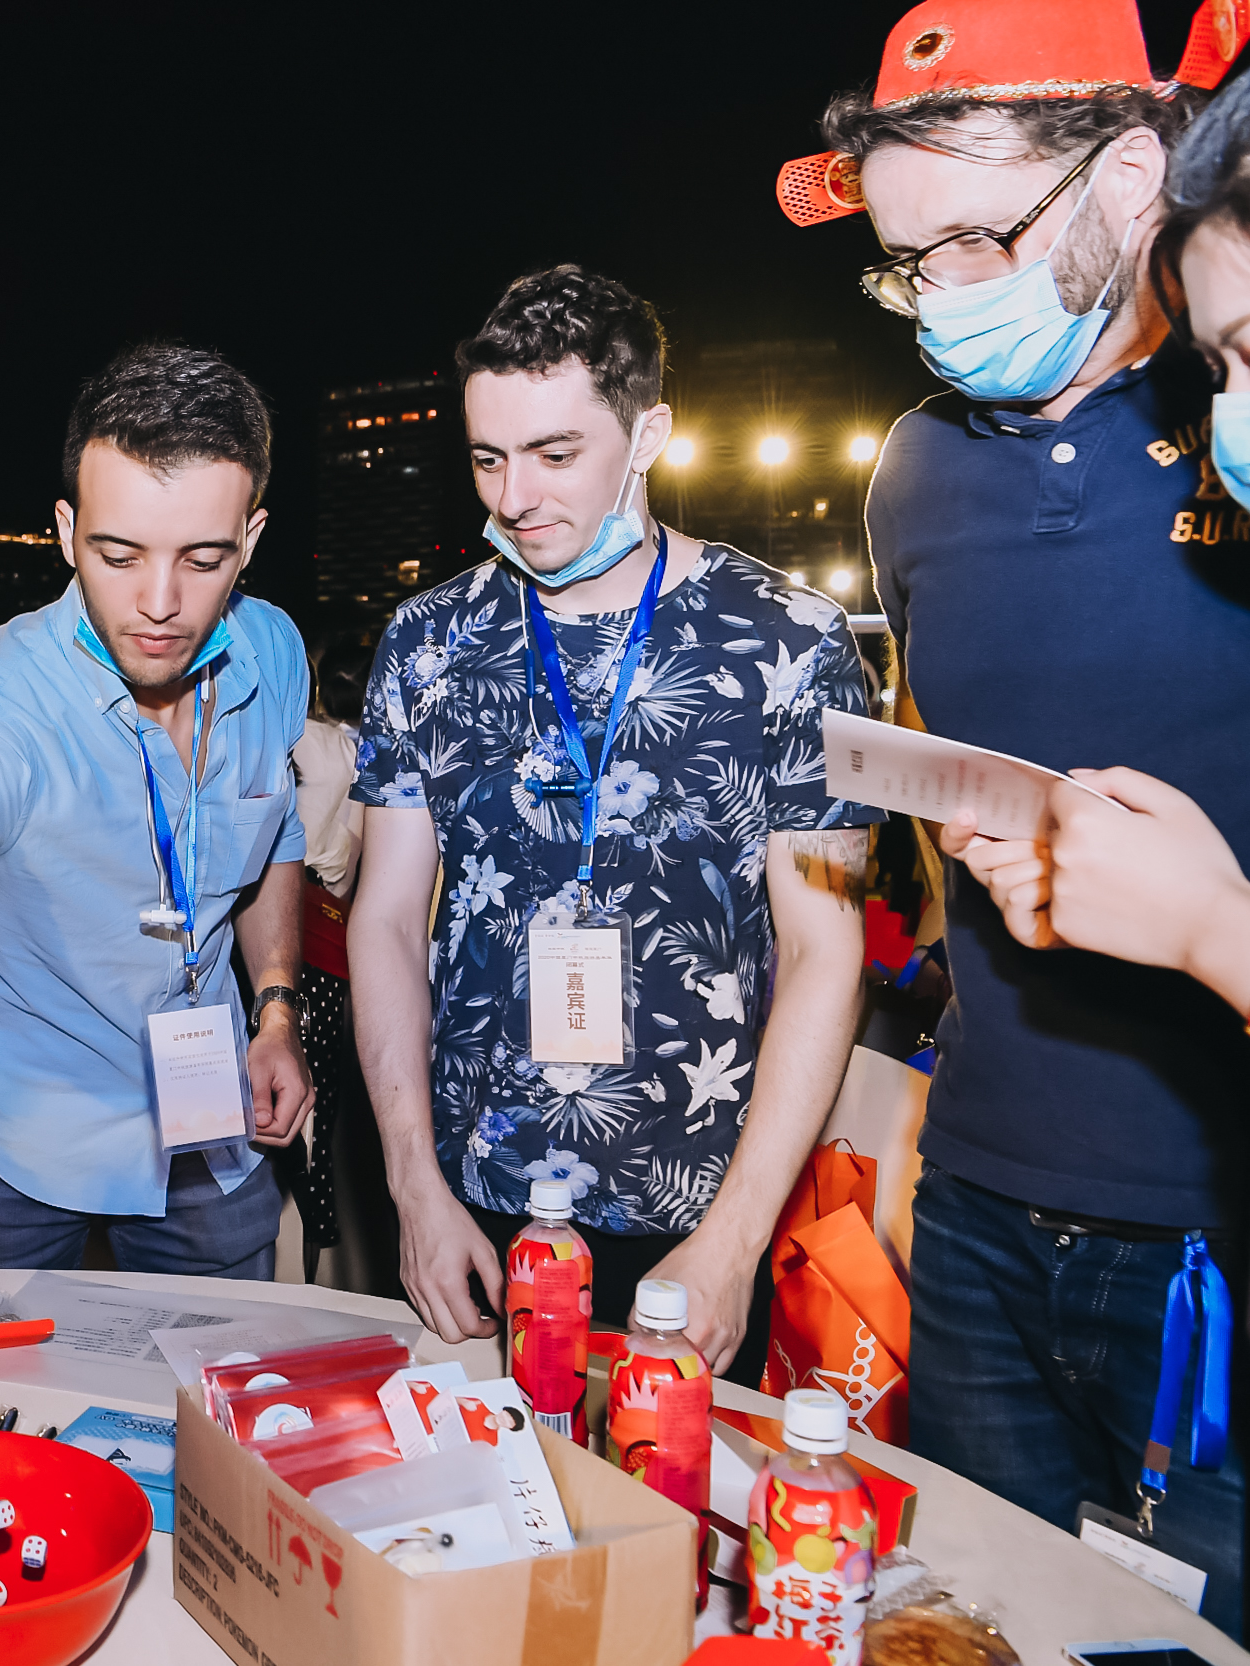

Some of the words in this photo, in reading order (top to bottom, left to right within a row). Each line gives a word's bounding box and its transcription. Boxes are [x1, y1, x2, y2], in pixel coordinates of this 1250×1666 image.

[566, 972, 587, 1030] 嘉宾证
[173, 1029, 214, 1041] 证件使用说明
[771, 1575, 843, 1612] 梅子
